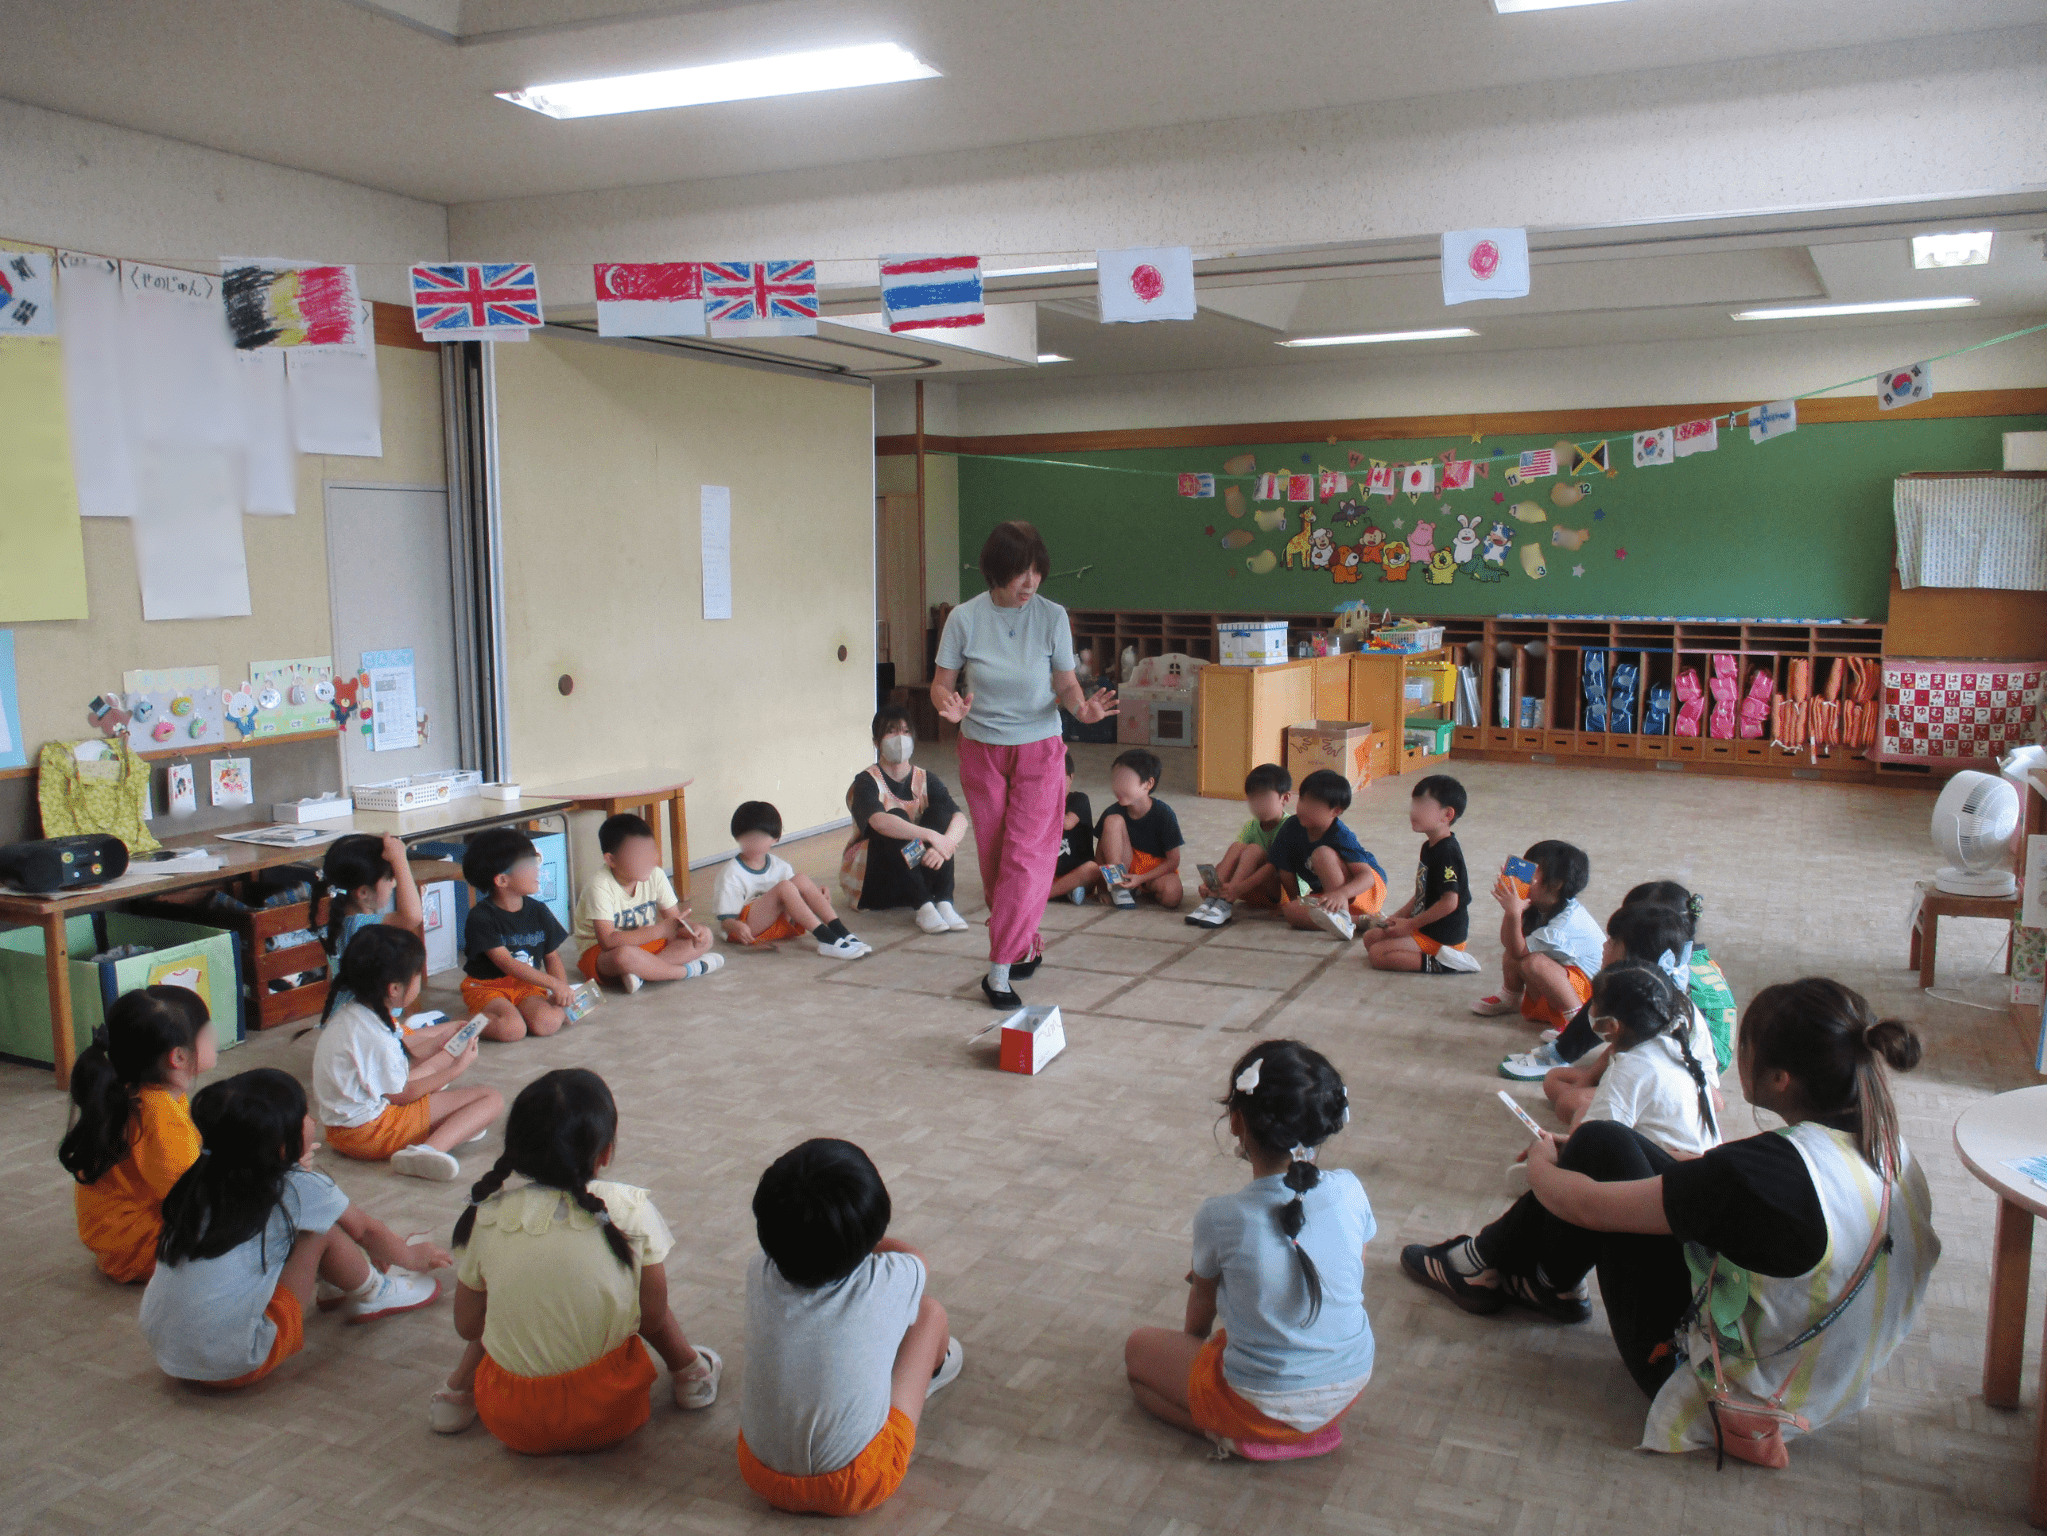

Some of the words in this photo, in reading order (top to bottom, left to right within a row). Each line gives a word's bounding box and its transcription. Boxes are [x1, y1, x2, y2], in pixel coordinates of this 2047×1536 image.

[1507, 474, 1518, 485] 11
[1580, 484, 1590, 494] 12
[1537, 566, 1546, 575] 3
[1889, 672, 1899, 681] わ
[1904, 673, 1913, 683] ら
[1919, 674, 1928, 683] や
[1934, 675, 1942, 684] ま
[1948, 675, 1958, 683] は
[1980, 675, 1989, 684] た
[1996, 675, 2004, 685] さ
[2012, 675, 2021, 683] か
[1903, 690, 1911, 699] り
[1932, 691, 1942, 699] み
[1947, 691, 1957, 700] ひ
[1963, 691, 1973, 700] に
[1980, 691, 1988, 701] ち
[1996, 691, 2003, 701] し
[2011, 691, 2019, 701] き
[2025, 690, 2035, 698] い
[1903, 706, 1911, 715] る
[1917, 707, 1926, 716] ゆ
[1931, 708, 1941, 717] む
[1946, 708, 1958, 716] ふ
[1978, 709, 1988, 717] つ
[2010, 709, 2016, 717] く
[1902, 723, 1911, 731] れ
[1931, 725, 1941, 733] め
[1961, 724, 1972, 734] ね
[1978, 725, 1987, 734] て
[1993, 725, 2003, 734] せ
[2008, 724, 2018, 734] け
[1887, 738, 1897, 746] ん
[1916, 740, 1925, 749] よ
[1945, 740, 1955, 749] ほ
[1961, 741, 1971, 749] の
[1978, 741, 1986, 750] と
